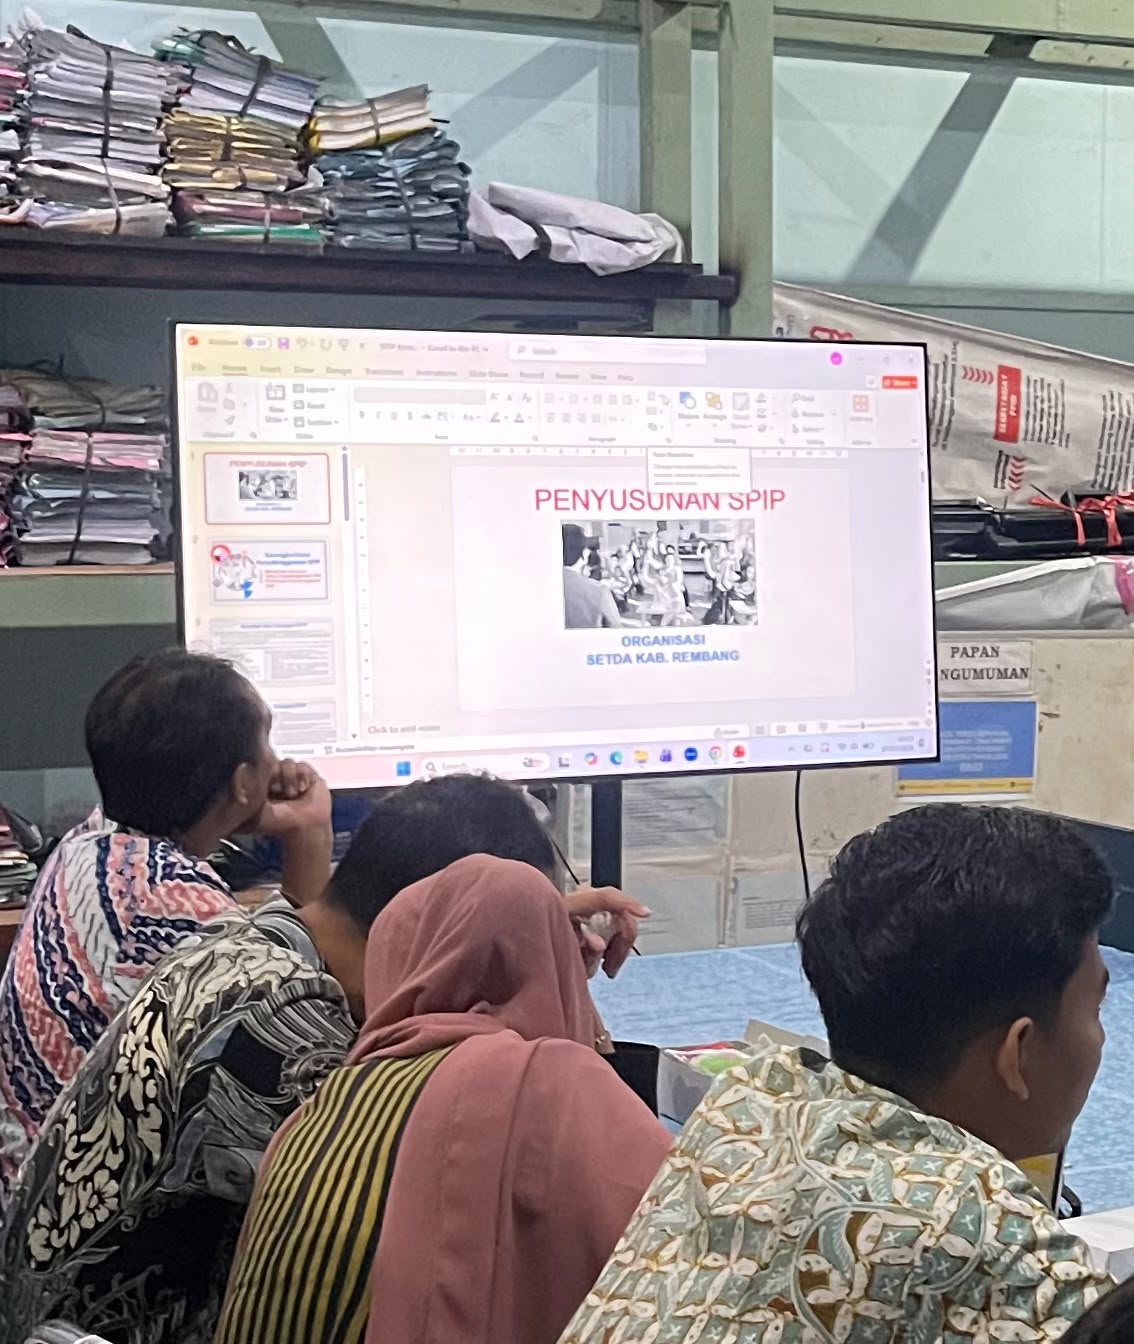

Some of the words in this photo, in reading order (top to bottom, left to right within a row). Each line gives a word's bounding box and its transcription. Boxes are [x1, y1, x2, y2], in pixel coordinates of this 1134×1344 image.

[535, 488, 719, 512] PENYUSUNAN
[728, 489, 786, 511] SPIP
[621, 634, 706, 647] ORGANISASI
[587, 653, 632, 666] SETDA
[636, 652, 669, 664] KAB.
[672, 650, 740, 664] REMBANG
[950, 645, 1001, 659] PAPAN
[940, 667, 1030, 681] NGUMUMAN
